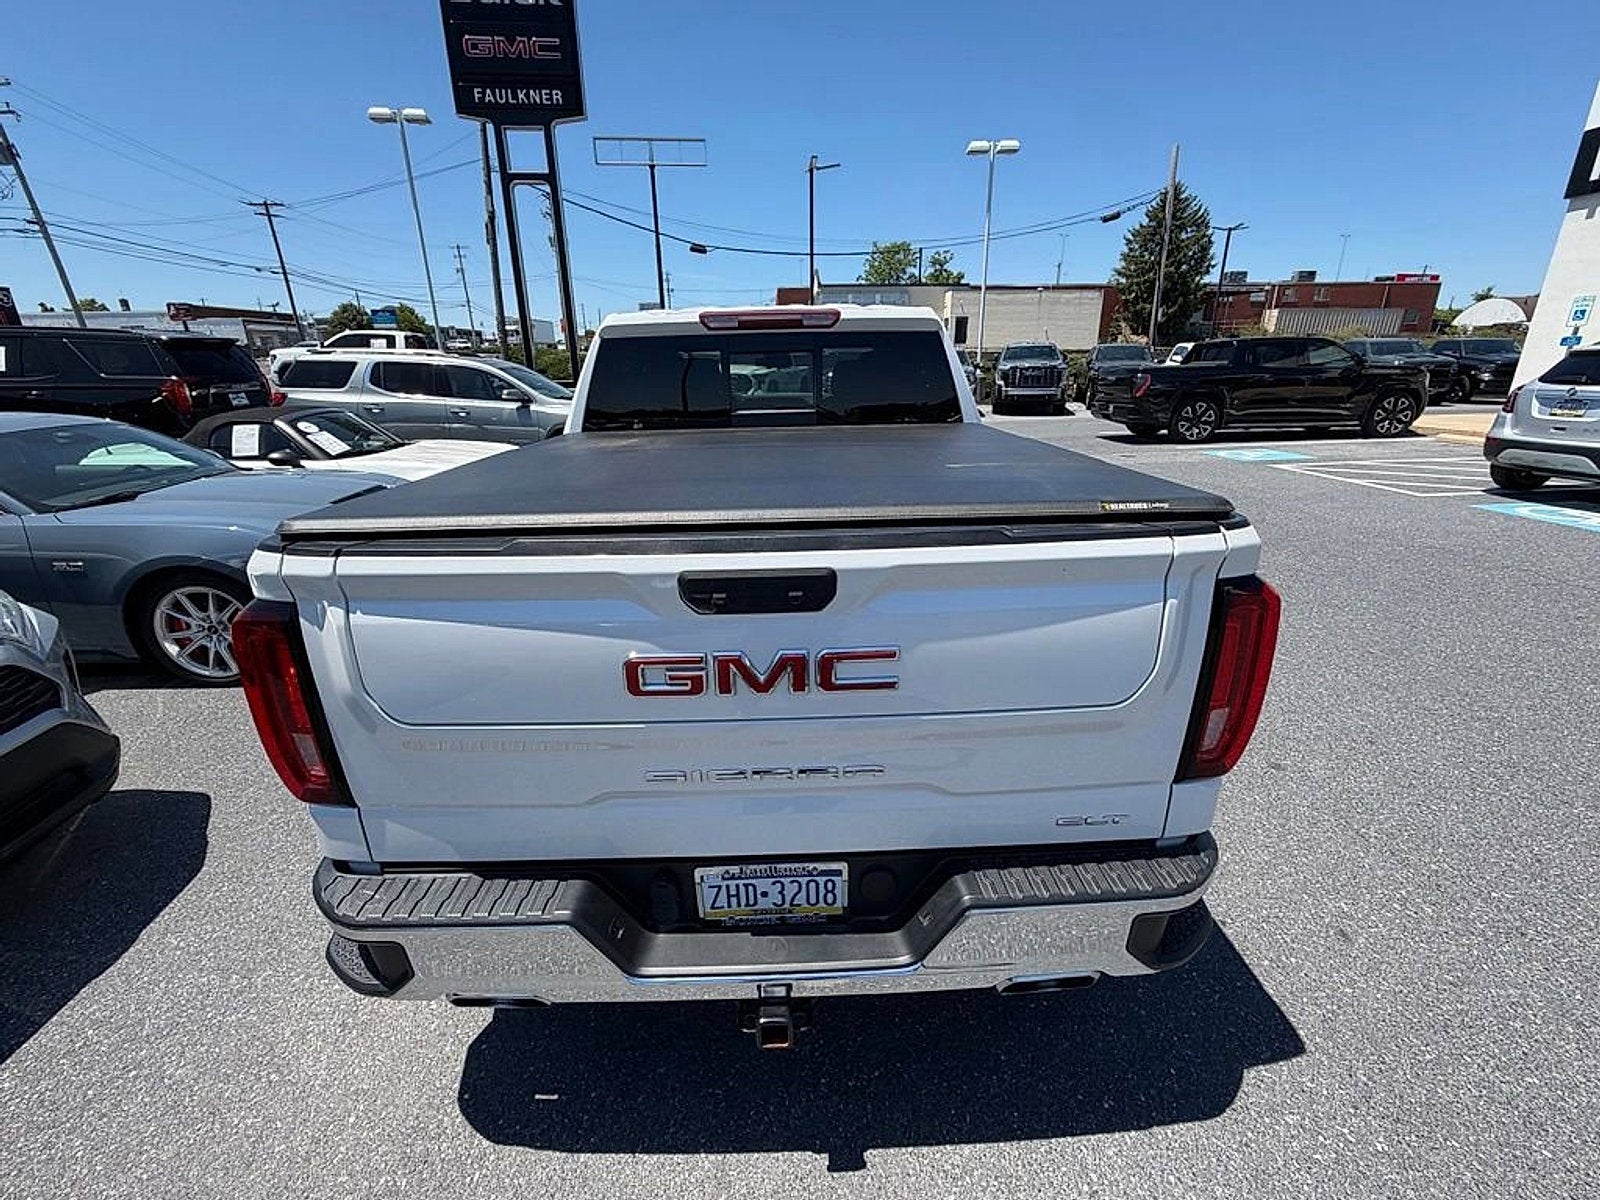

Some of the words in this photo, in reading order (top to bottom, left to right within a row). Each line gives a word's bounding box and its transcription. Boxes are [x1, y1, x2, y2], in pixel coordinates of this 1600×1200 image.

[463, 34, 562, 59] GMC
[473, 87, 563, 105] FAULKNER
[622, 645, 902, 699] GMC
[645, 763, 887, 784] SIERRA
